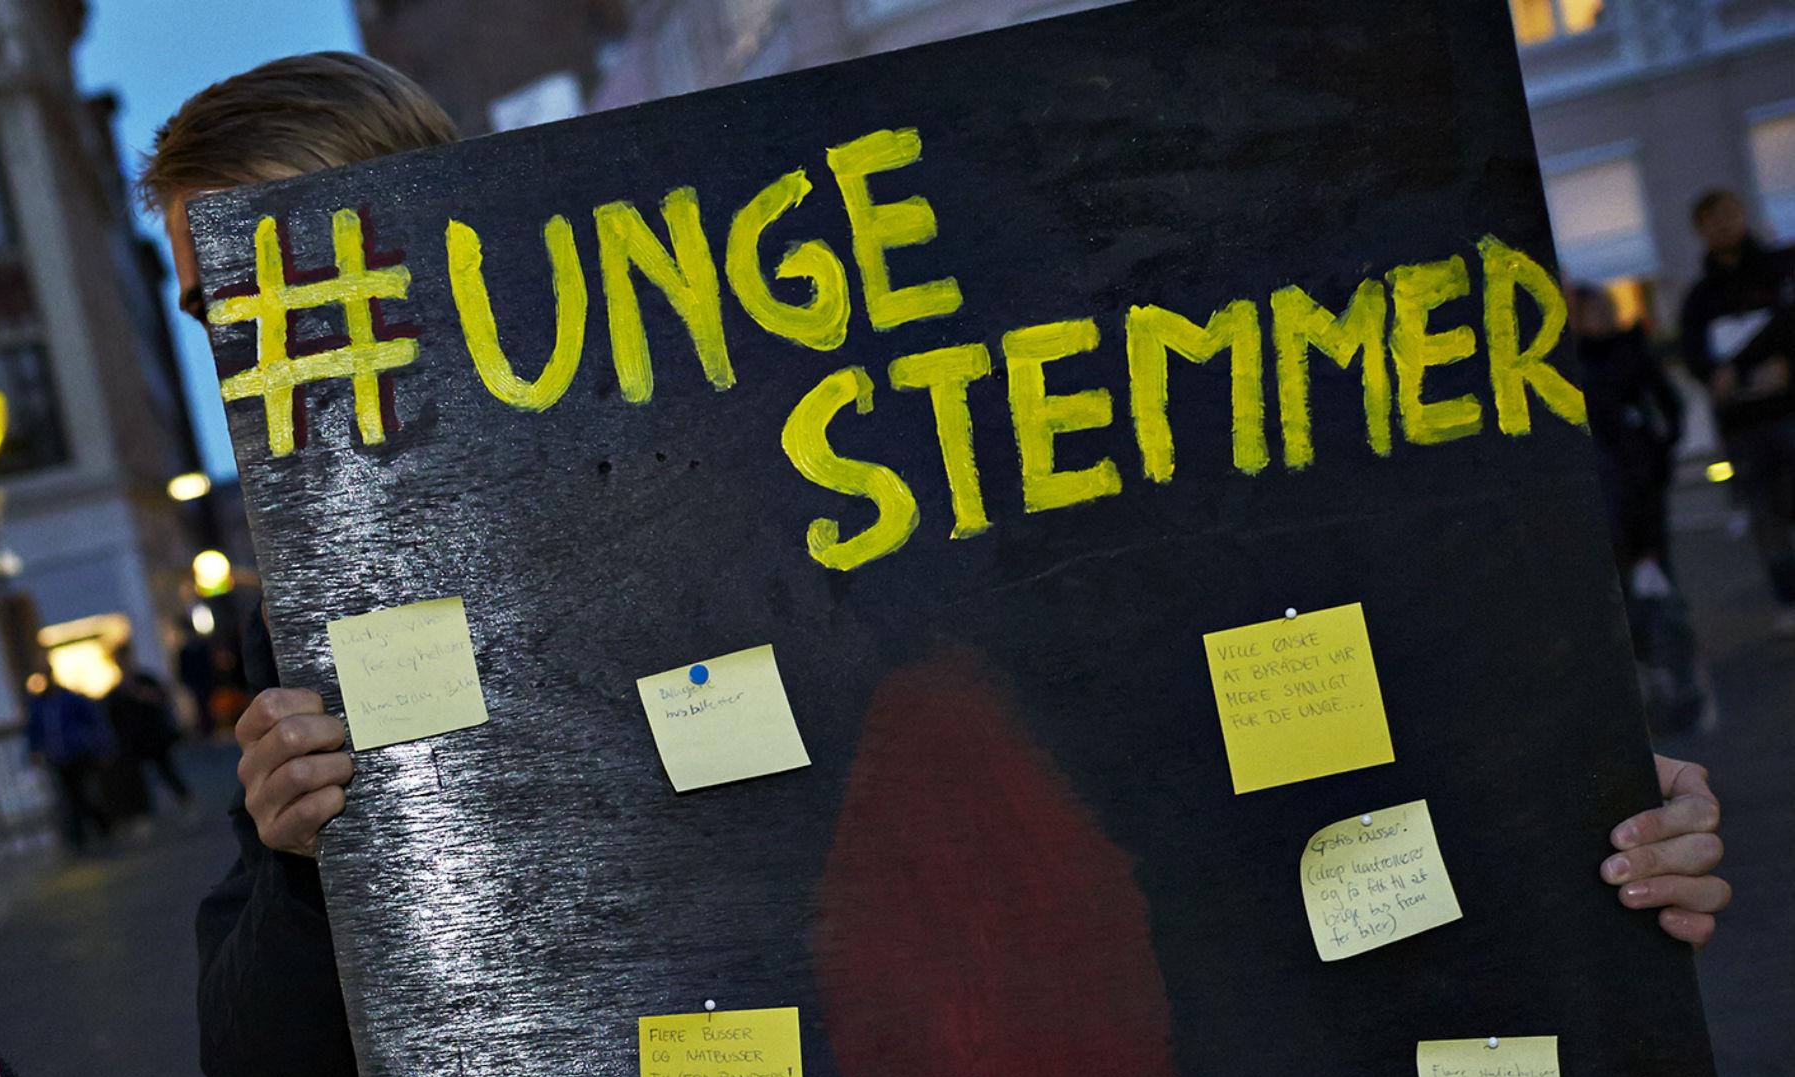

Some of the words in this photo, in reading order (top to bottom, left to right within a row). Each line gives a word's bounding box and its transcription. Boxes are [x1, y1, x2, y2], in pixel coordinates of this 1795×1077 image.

[208, 126, 962, 456] #UNGE
[781, 232, 1590, 572] STEMMER
[1217, 642, 1262, 660] VILLE
[1272, 632, 1320, 653] ØNSKE
[1223, 668, 1242, 683] AT
[1225, 689, 1270, 706] MERE
[1268, 708, 1291, 725] DE
[1310, 834, 1354, 856] Gratis
[1320, 886, 1344, 911] og
[649, 1028, 686, 1042] FLERE
[702, 1026, 753, 1042] BUSSER
[652, 1049, 671, 1063] OG
[685, 1049, 764, 1063] NATBUSSER
